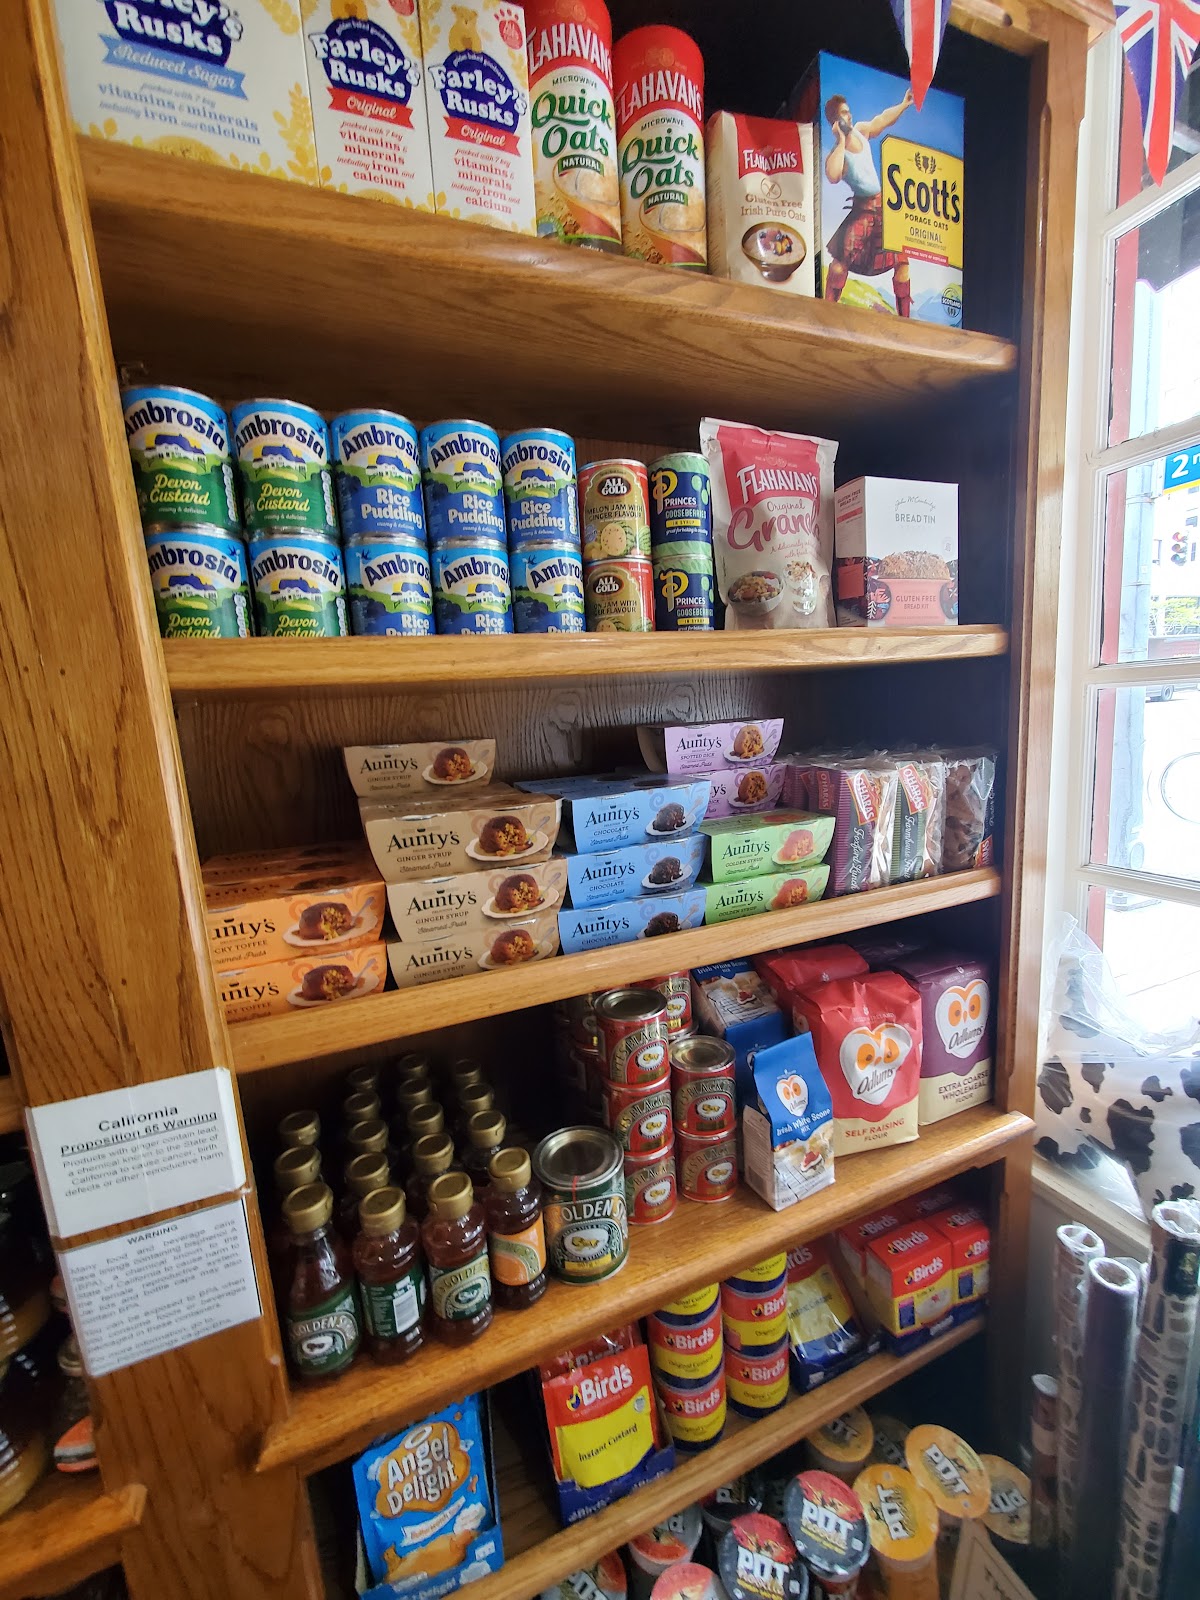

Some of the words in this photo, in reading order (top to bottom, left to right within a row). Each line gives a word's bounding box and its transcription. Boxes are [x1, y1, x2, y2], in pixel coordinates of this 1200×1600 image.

[113, 1, 224, 56] Rusks
[112, 44, 186, 75] Reduced
[187, 63, 238, 89] Sugar
[308, 33, 421, 87] Farley's
[328, 58, 406, 99] Rusks
[552, 75, 598, 89] MICROWAVE
[428, 64, 528, 116] Farley's
[98, 83, 176, 110] vitamins
[187, 104, 259, 132] minerals
[346, 96, 397, 120] Original
[446, 88, 515, 127] Rusks
[530, 88, 613, 133] Quick
[144, 107, 178, 125] iron
[199, 123, 261, 145] calcium
[460, 123, 506, 148] Original
[640, 118, 685, 132] MICROWAVE
[339, 130, 401, 152] vitamins
[542, 122, 610, 159] Oats
[344, 144, 405, 165] minerals
[620, 127, 700, 178] Quick
[742, 148, 798, 171] FLAHAVAN'S
[372, 159, 399, 175] iron
[453, 156, 509, 178] vitamins
[561, 156, 602, 172] NATURAL
[353, 170, 406, 189] calcium
[457, 170, 512, 192] minerals
[630, 158, 695, 200] Oats
[482, 185, 507, 202] iron
[648, 192, 685, 206] NATURAL
[745, 193, 779, 208] Gluten
[780, 197, 803, 210] Free
[886, 163, 961, 224] Scott's
[465, 195, 513, 215] calcium
[740, 205, 764, 218] Irish
[765, 207, 787, 219] Pure
[787, 209, 807, 224] Oats
[904, 212, 932, 227] PORAGE
[933, 222, 949, 232] OATS
[909, 226, 943, 244] ORIGINAL
[234, 414, 325, 460] Ambrosia
[155, 473, 202, 491] Devon
[260, 482, 303, 498] Devon
[601, 485, 628, 496] GOLD
[603, 477, 624, 487] ALL
[736, 463, 819, 505] FLAHAVAN'S
[150, 486, 211, 506] Custard
[256, 496, 311, 512] Custard
[375, 487, 411, 508] Rice
[462, 493, 494, 511] Rice
[664, 496, 697, 507] PRINCES
[766, 498, 806, 514] Original
[360, 503, 422, 528] Pudding
[520, 500, 552, 515] Rice
[588, 511, 613, 522] GINGER
[614, 510, 643, 520] FLAVOUR
[610, 504, 627, 512] JAM
[448, 508, 504, 533] Pudding
[510, 513, 566, 533] Pudding
[726, 500, 821, 553] Granola
[895, 513, 922, 523] BREAD
[923, 514, 936, 524] TIN
[251, 549, 340, 587] Ambrosia
[364, 553, 430, 587] Ambros
[595, 582, 620, 593] GOLD
[599, 574, 616, 585] ALL
[604, 601, 619, 609] JAM
[619, 600, 638, 609] WITH
[608, 606, 637, 616] FLAVOUR
[675, 596, 706, 606] PRINCES
[168, 613, 213, 627] Devon
[278, 614, 319, 629] Devon
[401, 612, 430, 630] Rice
[475, 613, 505, 629] Rice
[561, 612, 583, 627] Rice
[676, 736, 722, 752] Aunty's
[360, 757, 418, 775] Aunty's
[902, 767, 925, 812] O'HARAS
[585, 806, 640, 828] Aunty's
[593, 825, 629, 836] CHOCOLATE
[904, 815, 916, 857] Farmhouse
[385, 830, 460, 854] Aunty's
[722, 841, 770, 861] Aunty's
[853, 827, 866, 865] Foxford
[396, 853, 427, 864] GINGER
[427, 850, 453, 860] SYRUP
[725, 860, 747, 868] GOLDEN
[747, 857, 764, 866] SYRUP
[580, 863, 636, 885] Aunty's
[850, 863, 862, 891] Lunch
[589, 881, 625, 892] CHOCOLATE
[405, 890, 477, 916] Aunty's
[714, 890, 764, 910] Aunty's
[415, 915, 445, 925] GINGER
[445, 910, 470, 920] SYRUP
[718, 908, 738, 917] GOLDEN
[738, 905, 757, 914] SYRUP
[572, 917, 630, 939] Aunty's
[234, 939, 268, 951] TOFFEE
[581, 934, 619, 945] CHOCOLATE
[405, 947, 474, 972] Aunty's
[714, 963, 731, 972] White
[413, 970, 442, 979] GINGER
[442, 964, 467, 974] SYRUP
[948, 1025, 984, 1051] Odlums
[856, 1066, 897, 1096] Odlums
[938, 1080, 962, 1095] EXTRA
[962, 1069, 990, 1085] COARSE
[942, 1082, 986, 1101] WHOLEMEAL
[955, 1093, 974, 1104] FLOUR
[98, 1105, 179, 1132] California
[776, 1123, 793, 1137] Irish
[792, 1115, 811, 1130] White
[810, 1107, 831, 1121] Scone
[800, 1124, 811, 1134] MIX
[845, 1128, 868, 1139] SELF
[869, 1117, 905, 1134] RAISING
[60, 1130, 141, 1156] Proposition
[144, 1123, 160, 1135] 65
[163, 1111, 218, 1131] Warning
[864, 1131, 889, 1142] FLOUR
[62, 1151, 107, 1169] Products
[77, 1158, 120, 1175] chemical
[142, 1156, 199, 1178] reproductive
[561, 1199, 614, 1222] OLDEN
[126, 1223, 179, 1246] WARNING
[892, 1230, 929, 1253] Bird's
[912, 1256, 943, 1282] Bird's
[674, 1327, 715, 1350] Bird's
[751, 1357, 786, 1382] Bird's
[581, 1363, 633, 1407] Bird's
[684, 1388, 721, 1415] Bird's
[578, 1443, 608, 1463] Instant
[607, 1422, 639, 1447] Custard
[386, 1427, 450, 1491] Angel
[386, 1459, 459, 1516] Delight
[801, 1496, 854, 1543] POT
[737, 1545, 791, 1588] POT
